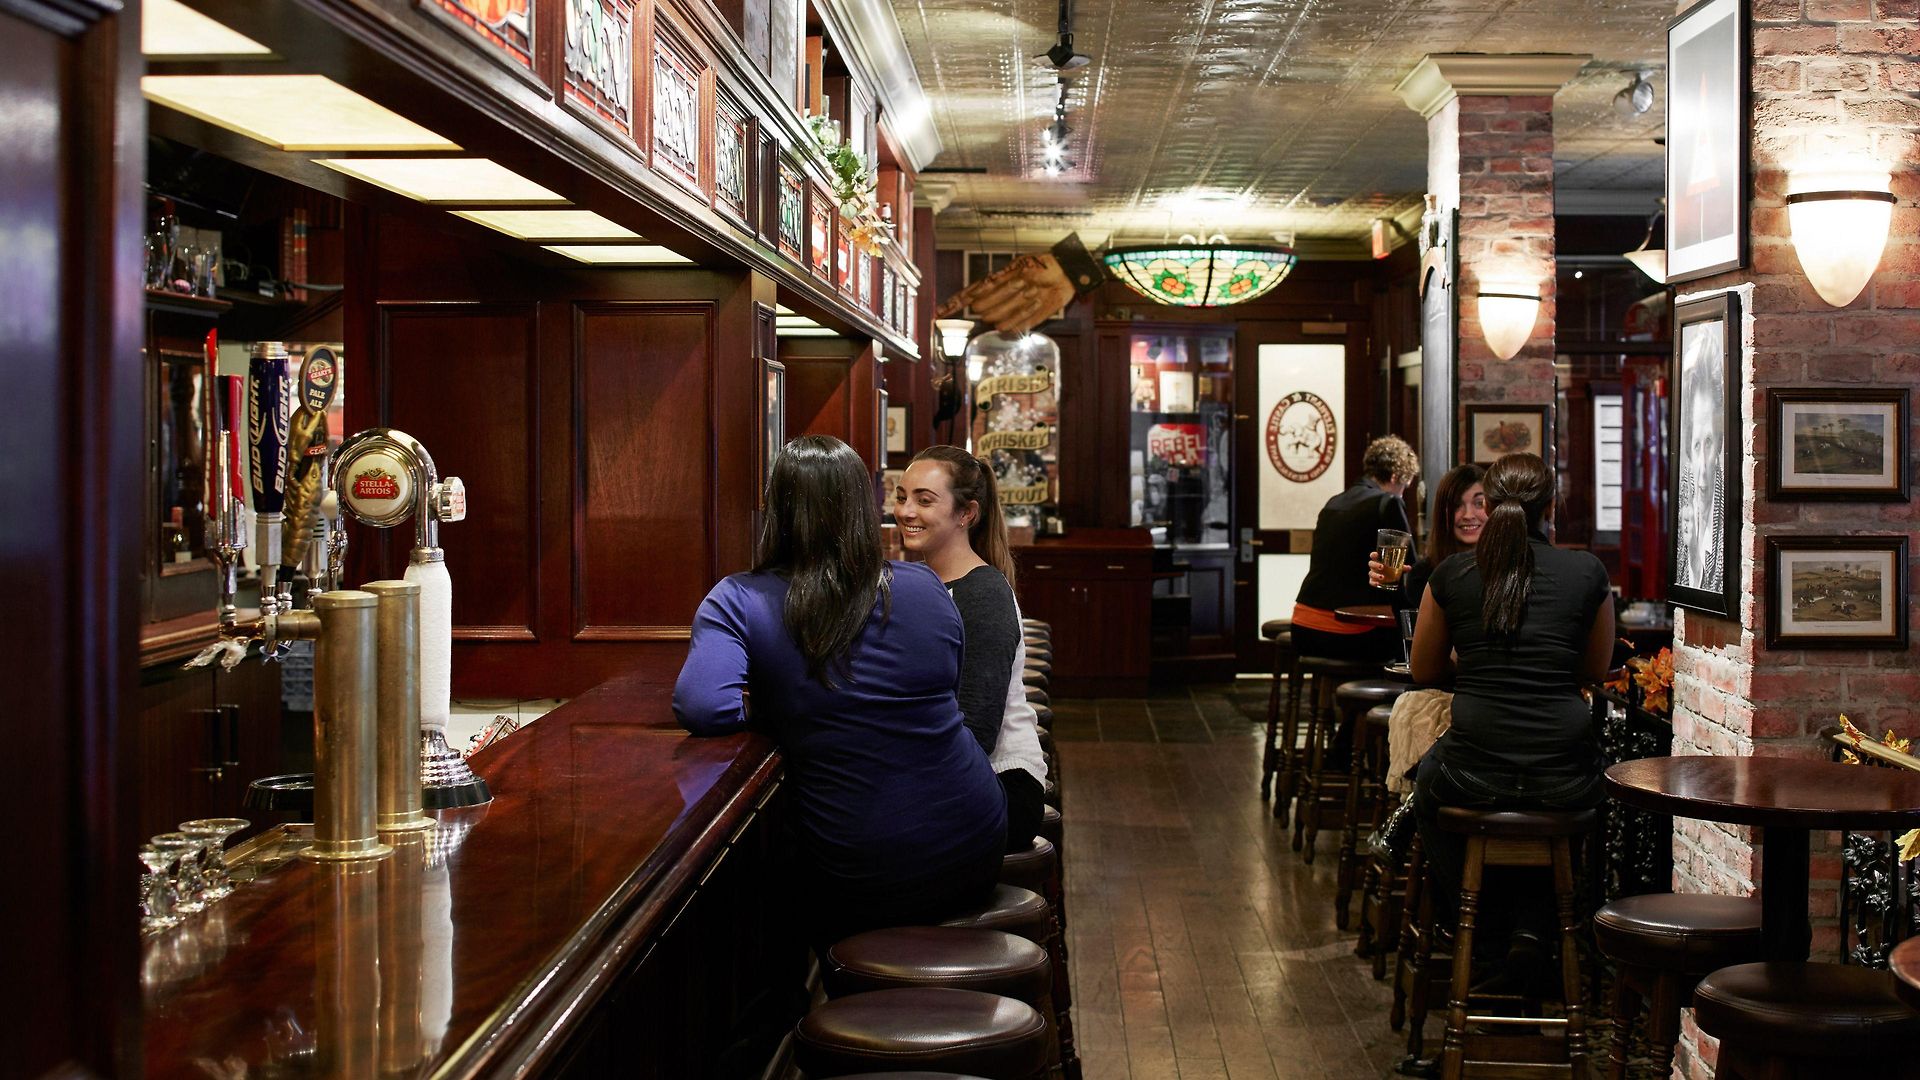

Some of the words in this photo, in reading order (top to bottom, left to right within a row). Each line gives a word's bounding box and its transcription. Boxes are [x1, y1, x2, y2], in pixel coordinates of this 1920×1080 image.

[309, 387, 326, 399] PALE
[988, 377, 1041, 394] IRISH
[249, 375, 261, 441] LIGHT
[279, 375, 290, 441] LIGHT
[309, 399, 323, 409] ALE
[980, 432, 1048, 451] WHISKEY
[251, 445, 265, 494] BUD
[274, 445, 288, 494] BUD
[360, 480, 391, 488] STELLA
[999, 486, 1046, 503] STOUT
